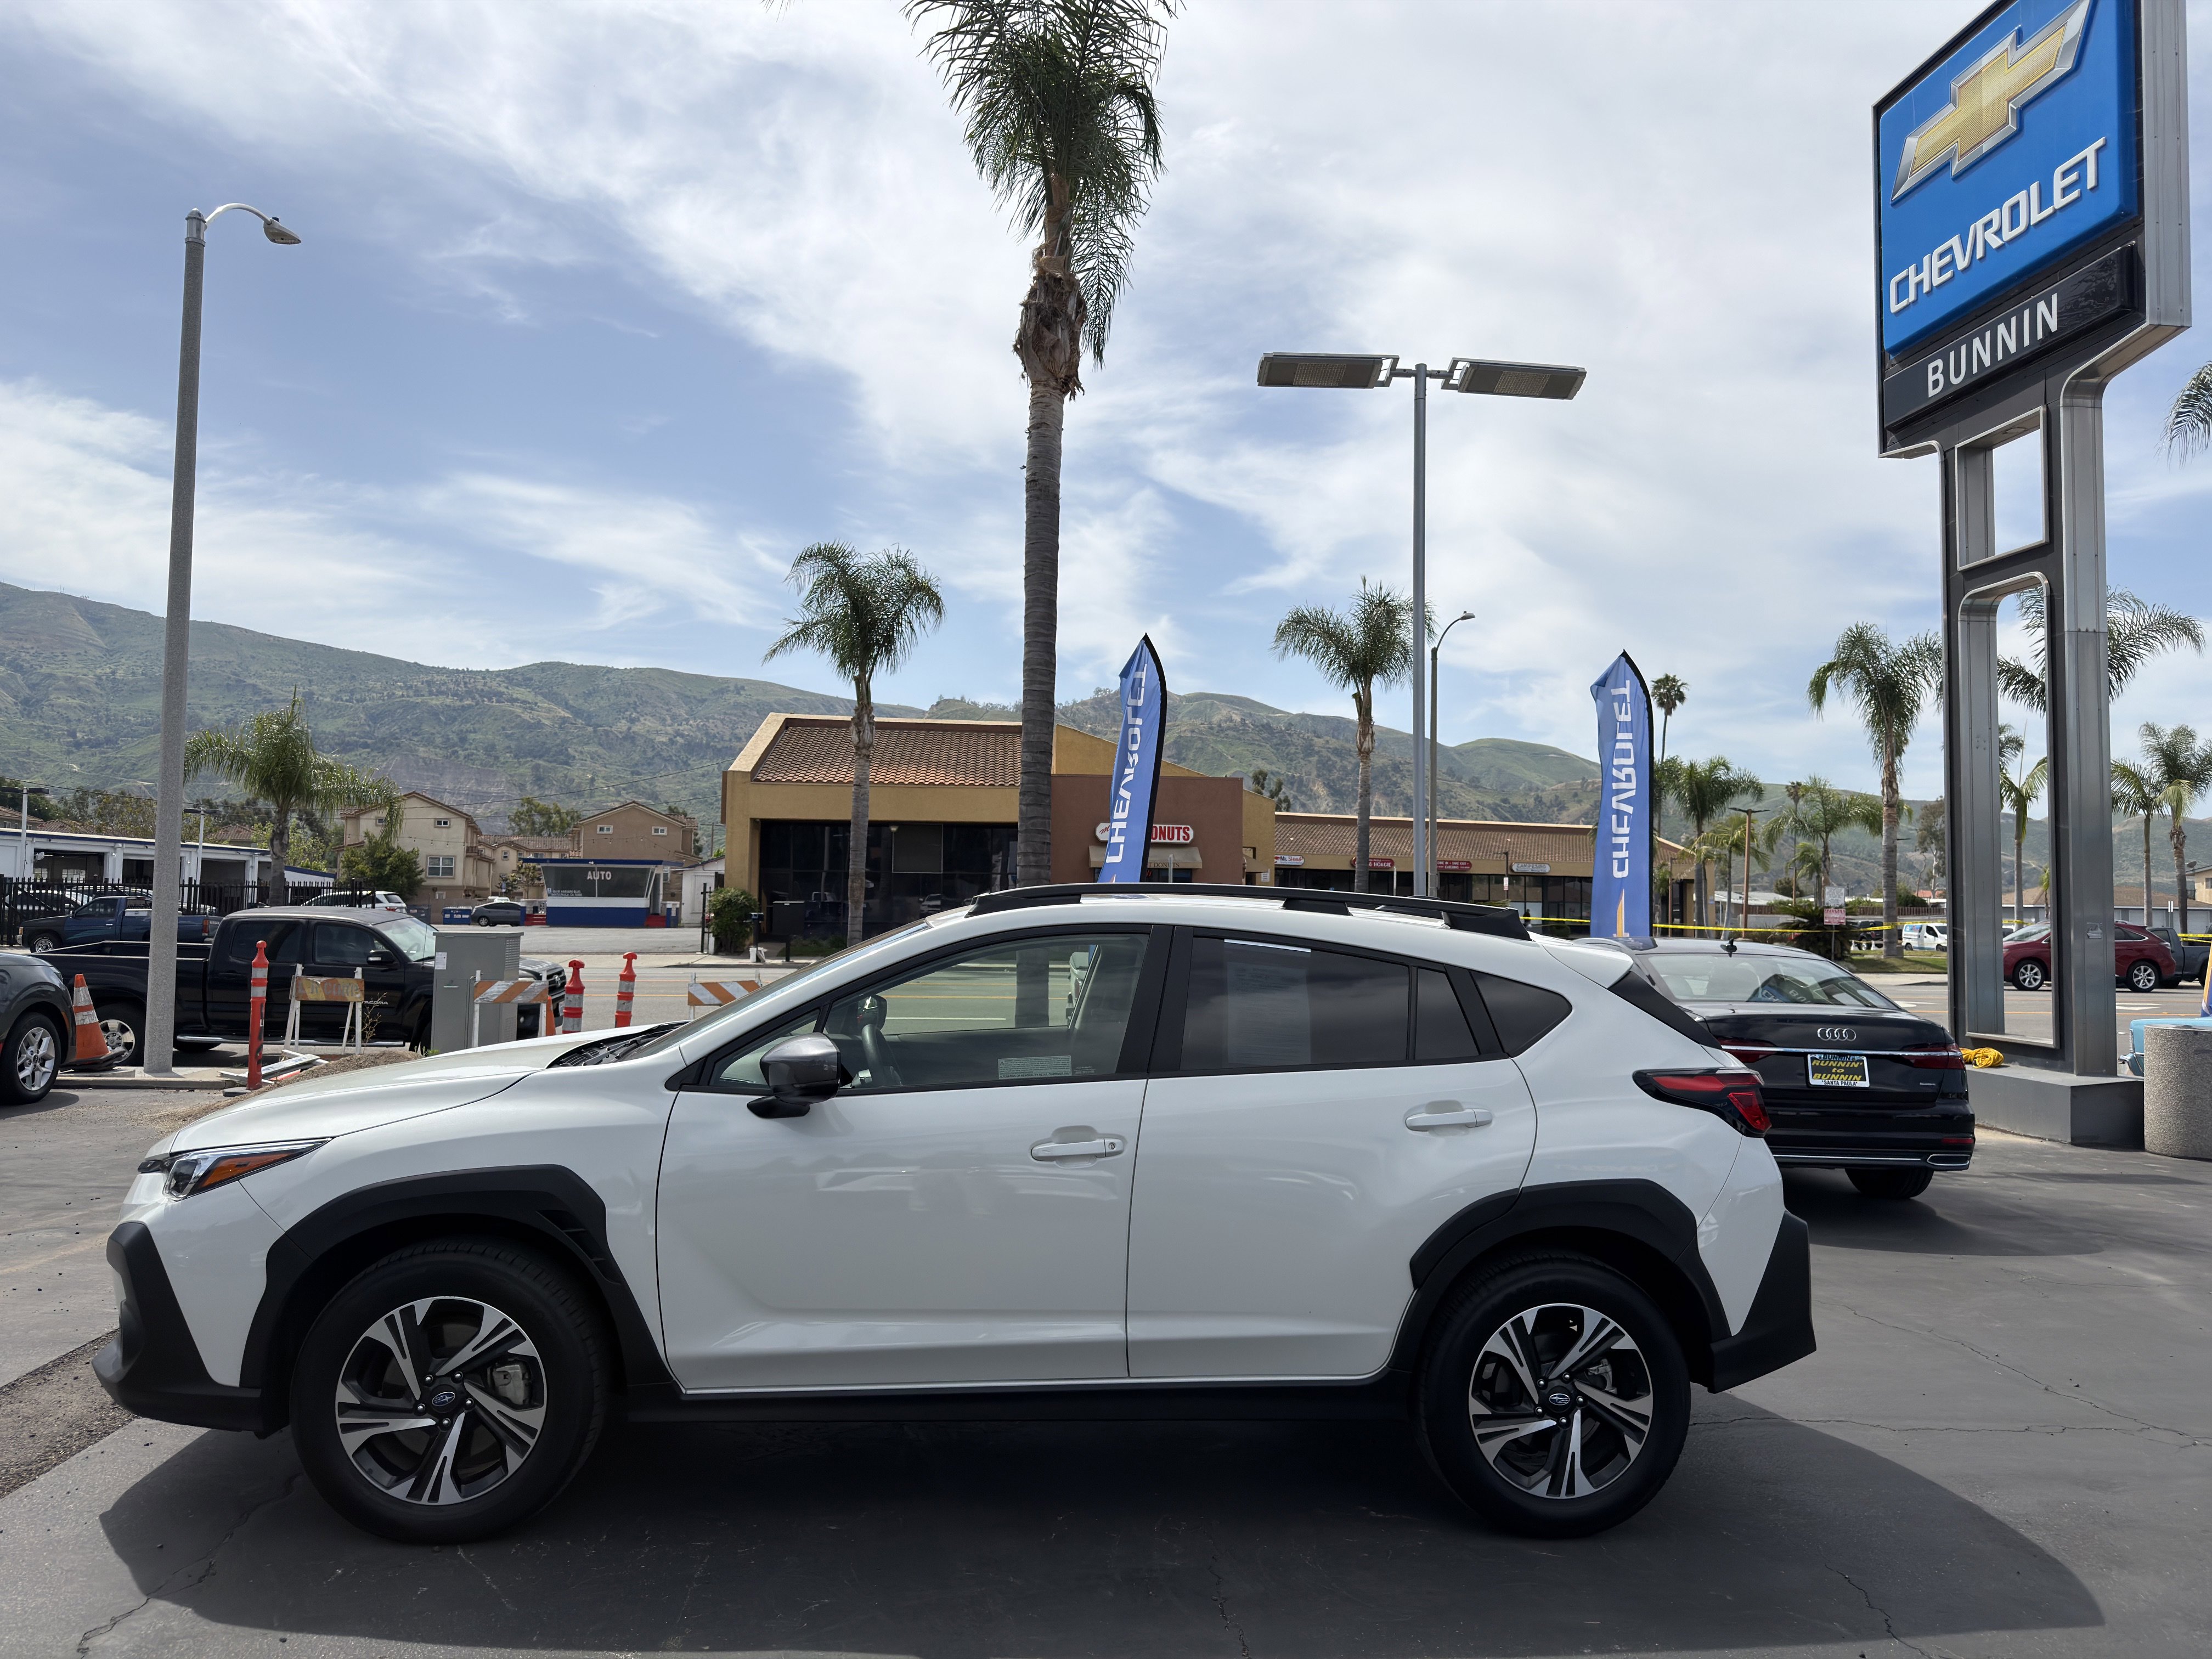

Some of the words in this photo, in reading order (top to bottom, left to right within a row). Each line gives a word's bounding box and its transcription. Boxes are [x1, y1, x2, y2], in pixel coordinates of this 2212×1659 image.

[1890, 137, 2107, 314] CHEVROLET
[1928, 294, 2058, 398] BUNNIN
[1152, 826, 1190, 841] ONUTS
[587, 871, 612, 880] AUTO
